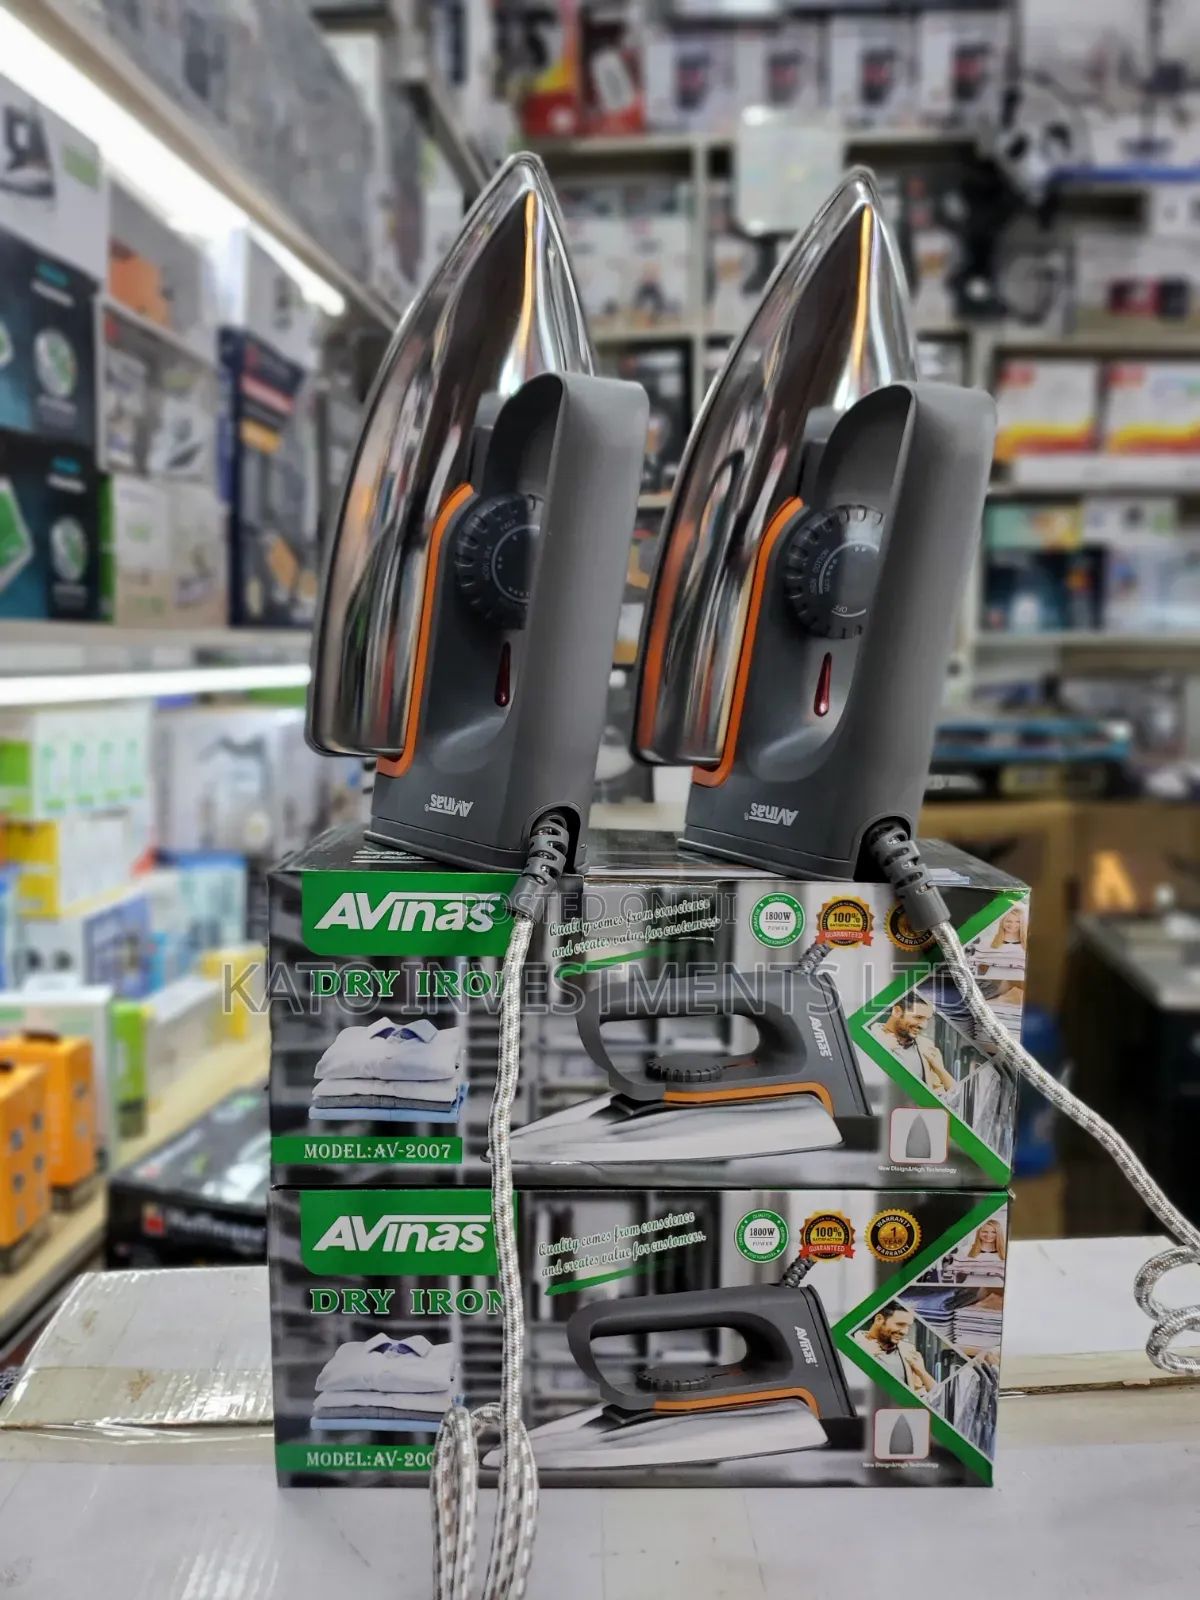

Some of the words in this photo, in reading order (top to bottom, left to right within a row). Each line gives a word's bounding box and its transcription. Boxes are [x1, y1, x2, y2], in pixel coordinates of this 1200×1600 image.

[549, 917, 591, 937] Quality
[593, 915, 623, 930] comes
[626, 909, 653, 929] from
[654, 898, 711, 919] conscience
[765, 911, 791, 921] 1800W
[832, 912, 861, 924] 100%
[824, 930, 863, 939] GUARANTEED
[552, 940, 573, 958] and
[574, 935, 611, 955] creates
[612, 928, 644, 946] value
[644, 924, 663, 944] for
[311, 969, 400, 998] DRY
[304, 1141, 452, 1160] MODEL:AV-2007
[875, 1215, 912, 1229] WARRANTY
[538, 1237, 580, 1256] Quality
[581, 1231, 612, 1248] comes
[613, 1224, 641, 1242] from
[641, 1211, 695, 1233] conscience
[749, 1227, 776, 1237] 1800W
[815, 1226, 843, 1238] 100%
[890, 1226, 898, 1238] 1
[884, 1237, 904, 1245] YEAR
[808, 1244, 846, 1252] GUARANTEED
[875, 1244, 911, 1256] WARRANTY
[541, 1259, 562, 1278] and
[562, 1255, 600, 1274] creates
[600, 1245, 632, 1264] value
[632, 1240, 651, 1262] for
[309, 1288, 396, 1316] DRY
